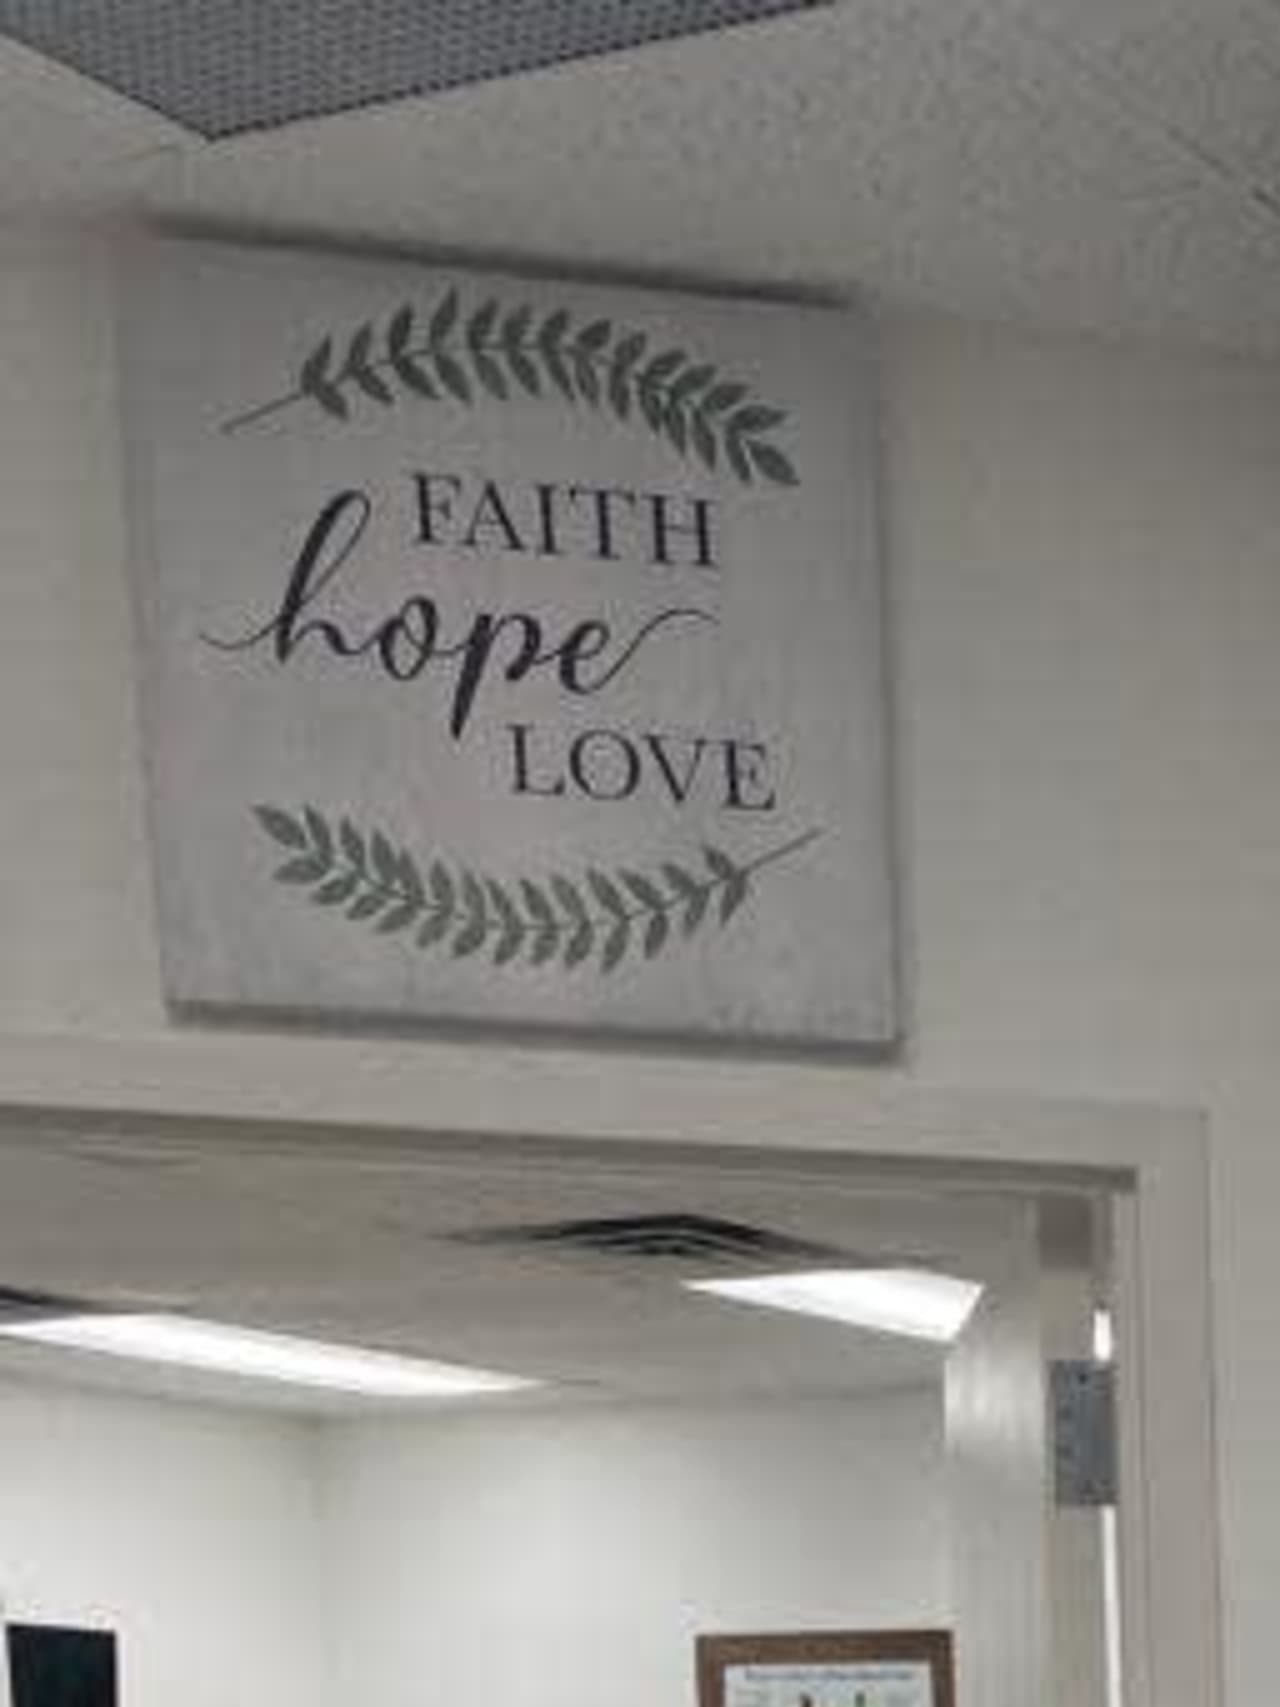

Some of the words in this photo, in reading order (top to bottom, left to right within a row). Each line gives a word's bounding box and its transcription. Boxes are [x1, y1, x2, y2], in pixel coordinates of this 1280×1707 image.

[411, 472, 718, 567] FAITH
[199, 488, 718, 740] hope
[508, 725, 775, 811] LOVE
